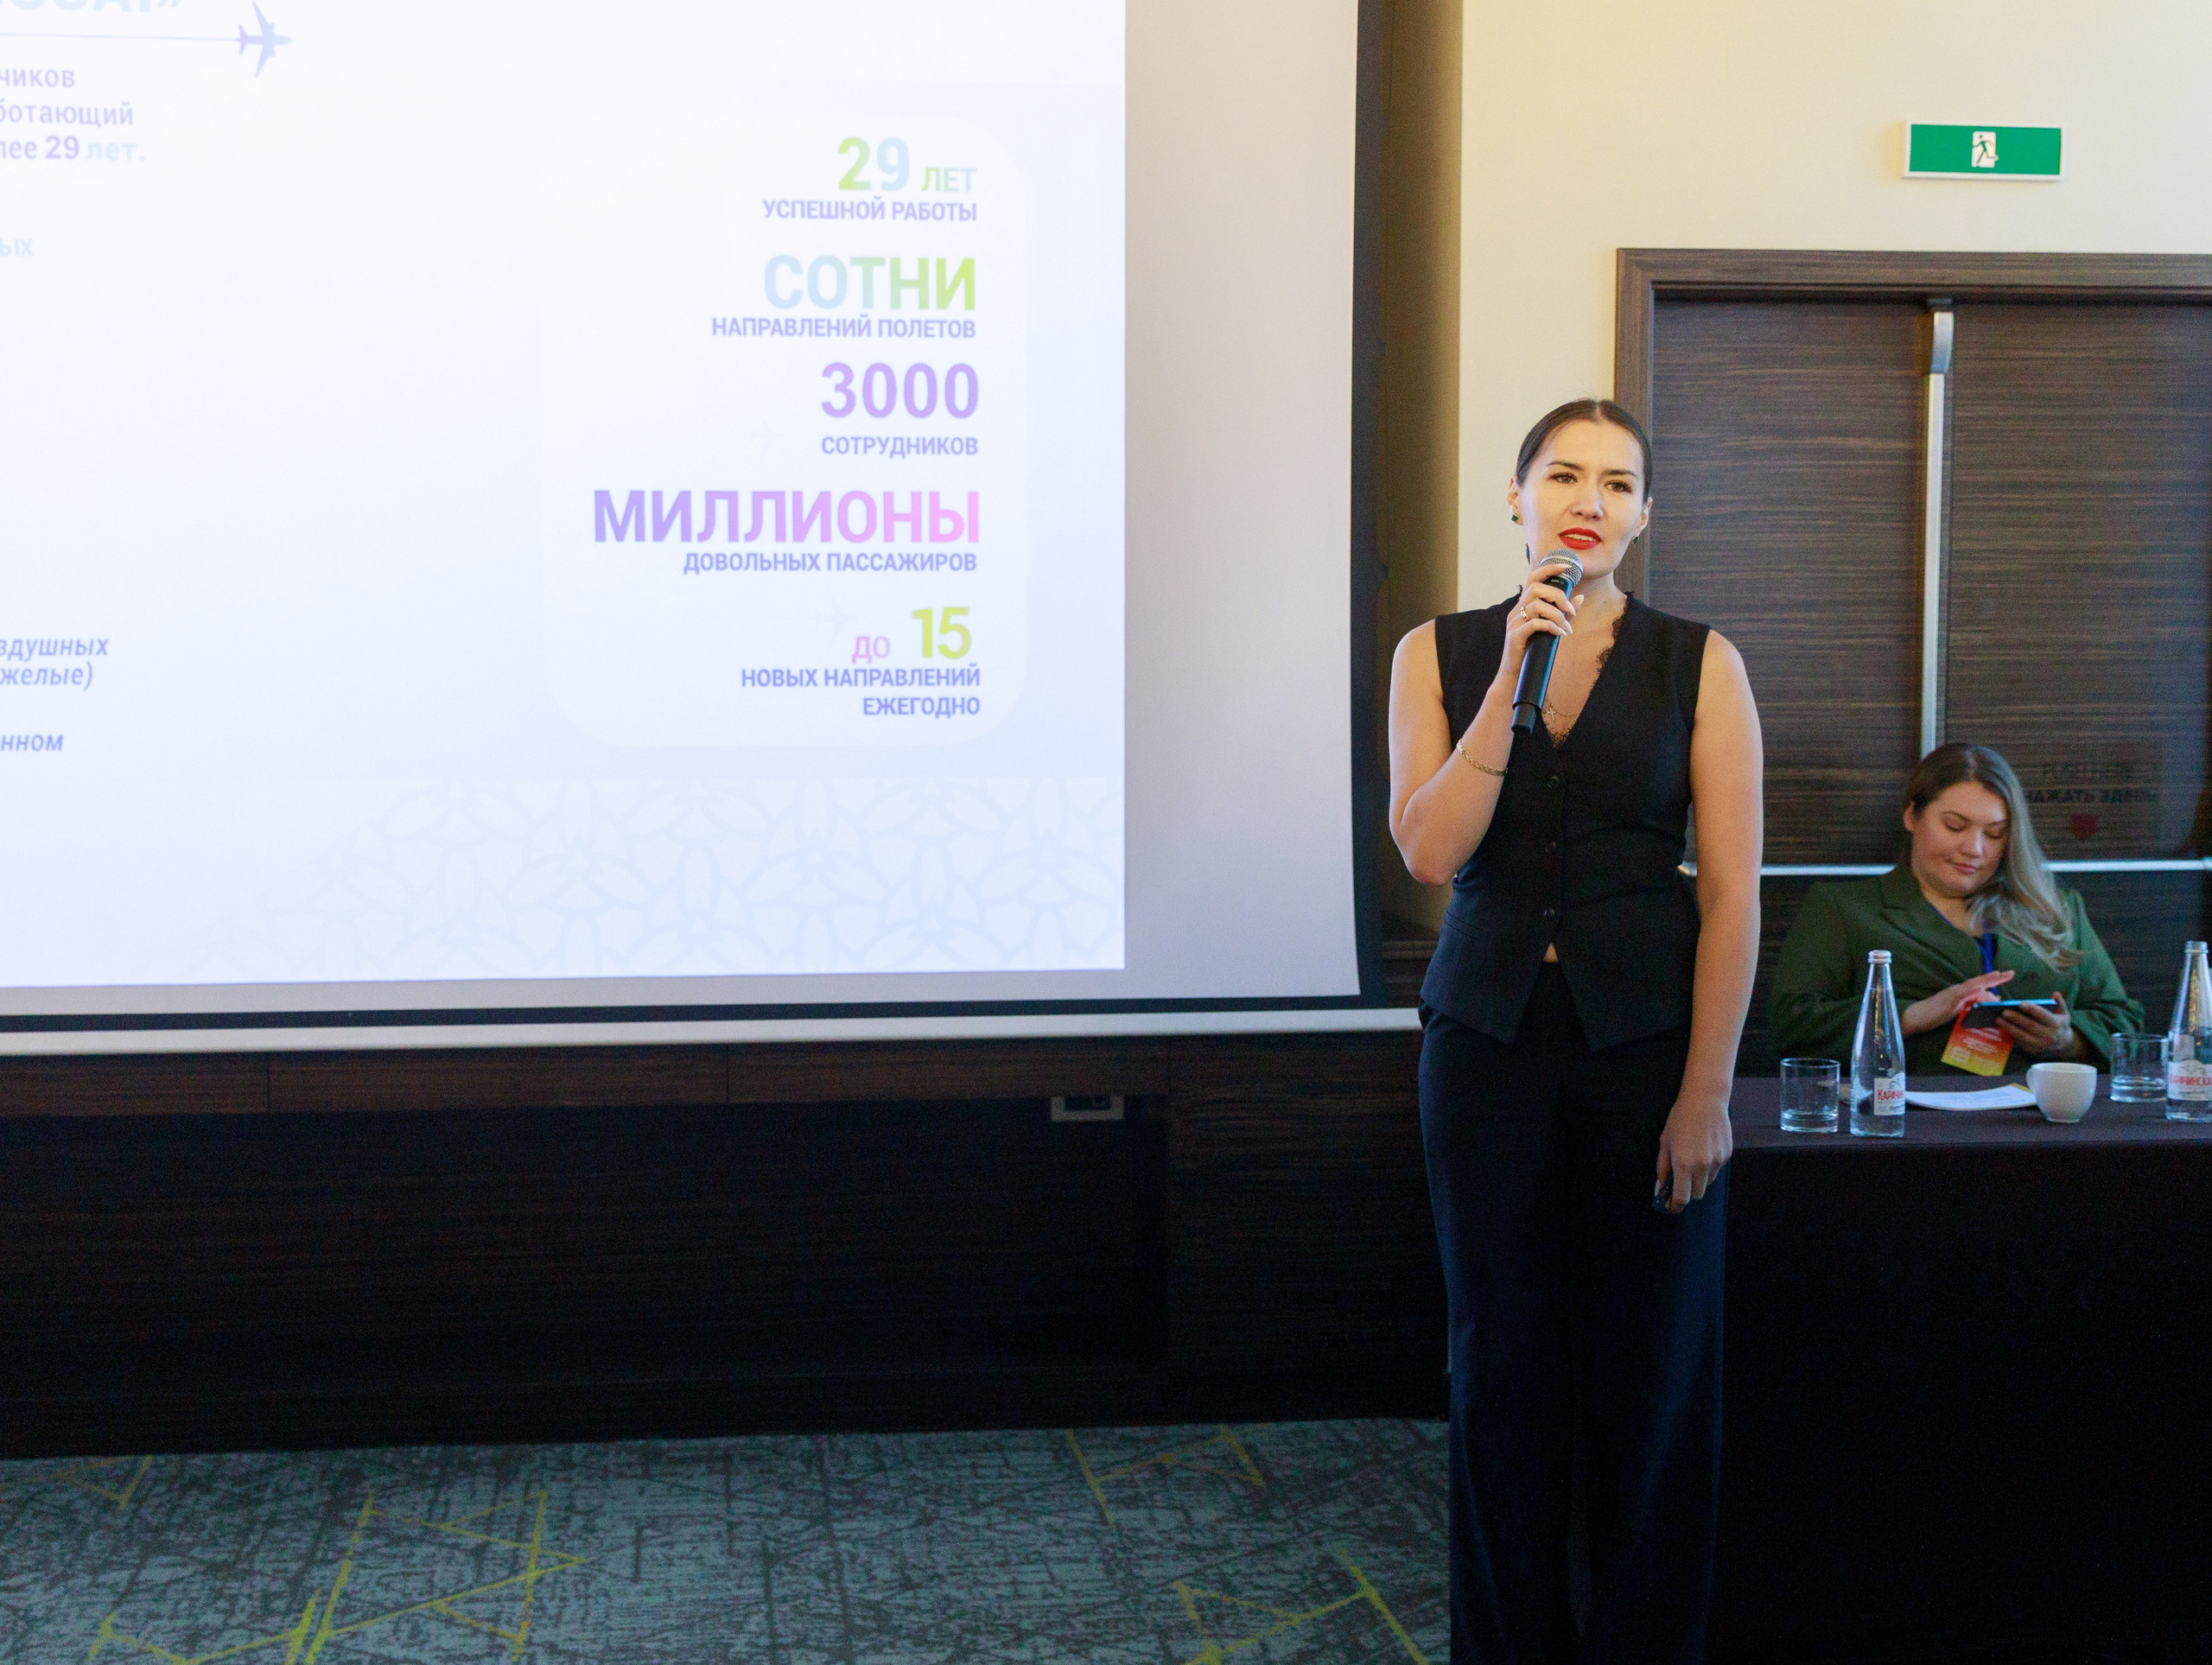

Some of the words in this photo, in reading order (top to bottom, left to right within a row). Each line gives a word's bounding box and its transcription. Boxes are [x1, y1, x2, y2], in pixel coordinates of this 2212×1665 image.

[0, 69, 75, 87] чиков
[46, 135, 79, 160] 29
[86, 143, 145, 161] лет.
[837, 136, 910, 192] 29
[921, 166, 976, 193] ЛЕТ
[763, 196, 885, 219] УСПЕШНОЙ
[892, 201, 976, 221] РАБОТЫ
[764, 254, 976, 311] СОТНИ
[712, 314, 872, 338] НАПРАВЛЕНИЙ
[878, 319, 976, 339] ПОЛЕТОВ
[821, 361, 979, 419] 3000
[821, 435, 978, 459] СОТРУДНИКОВ
[594, 489, 979, 543] МИЛЛИОНЫ
[683, 552, 821, 575] ДОВОЛЬНЫХ
[827, 552, 977, 572] ПАССАЖИРОВ
[851, 635, 890, 664] ДО
[911, 606, 972, 660] 15
[741, 668, 818, 688] НОВЫХ
[823, 662, 981, 687] НАПРАВЛЕНИЙ
[862, 696, 981, 719] ЕЖЕГОДНО
[0, 734, 64, 752] нном
